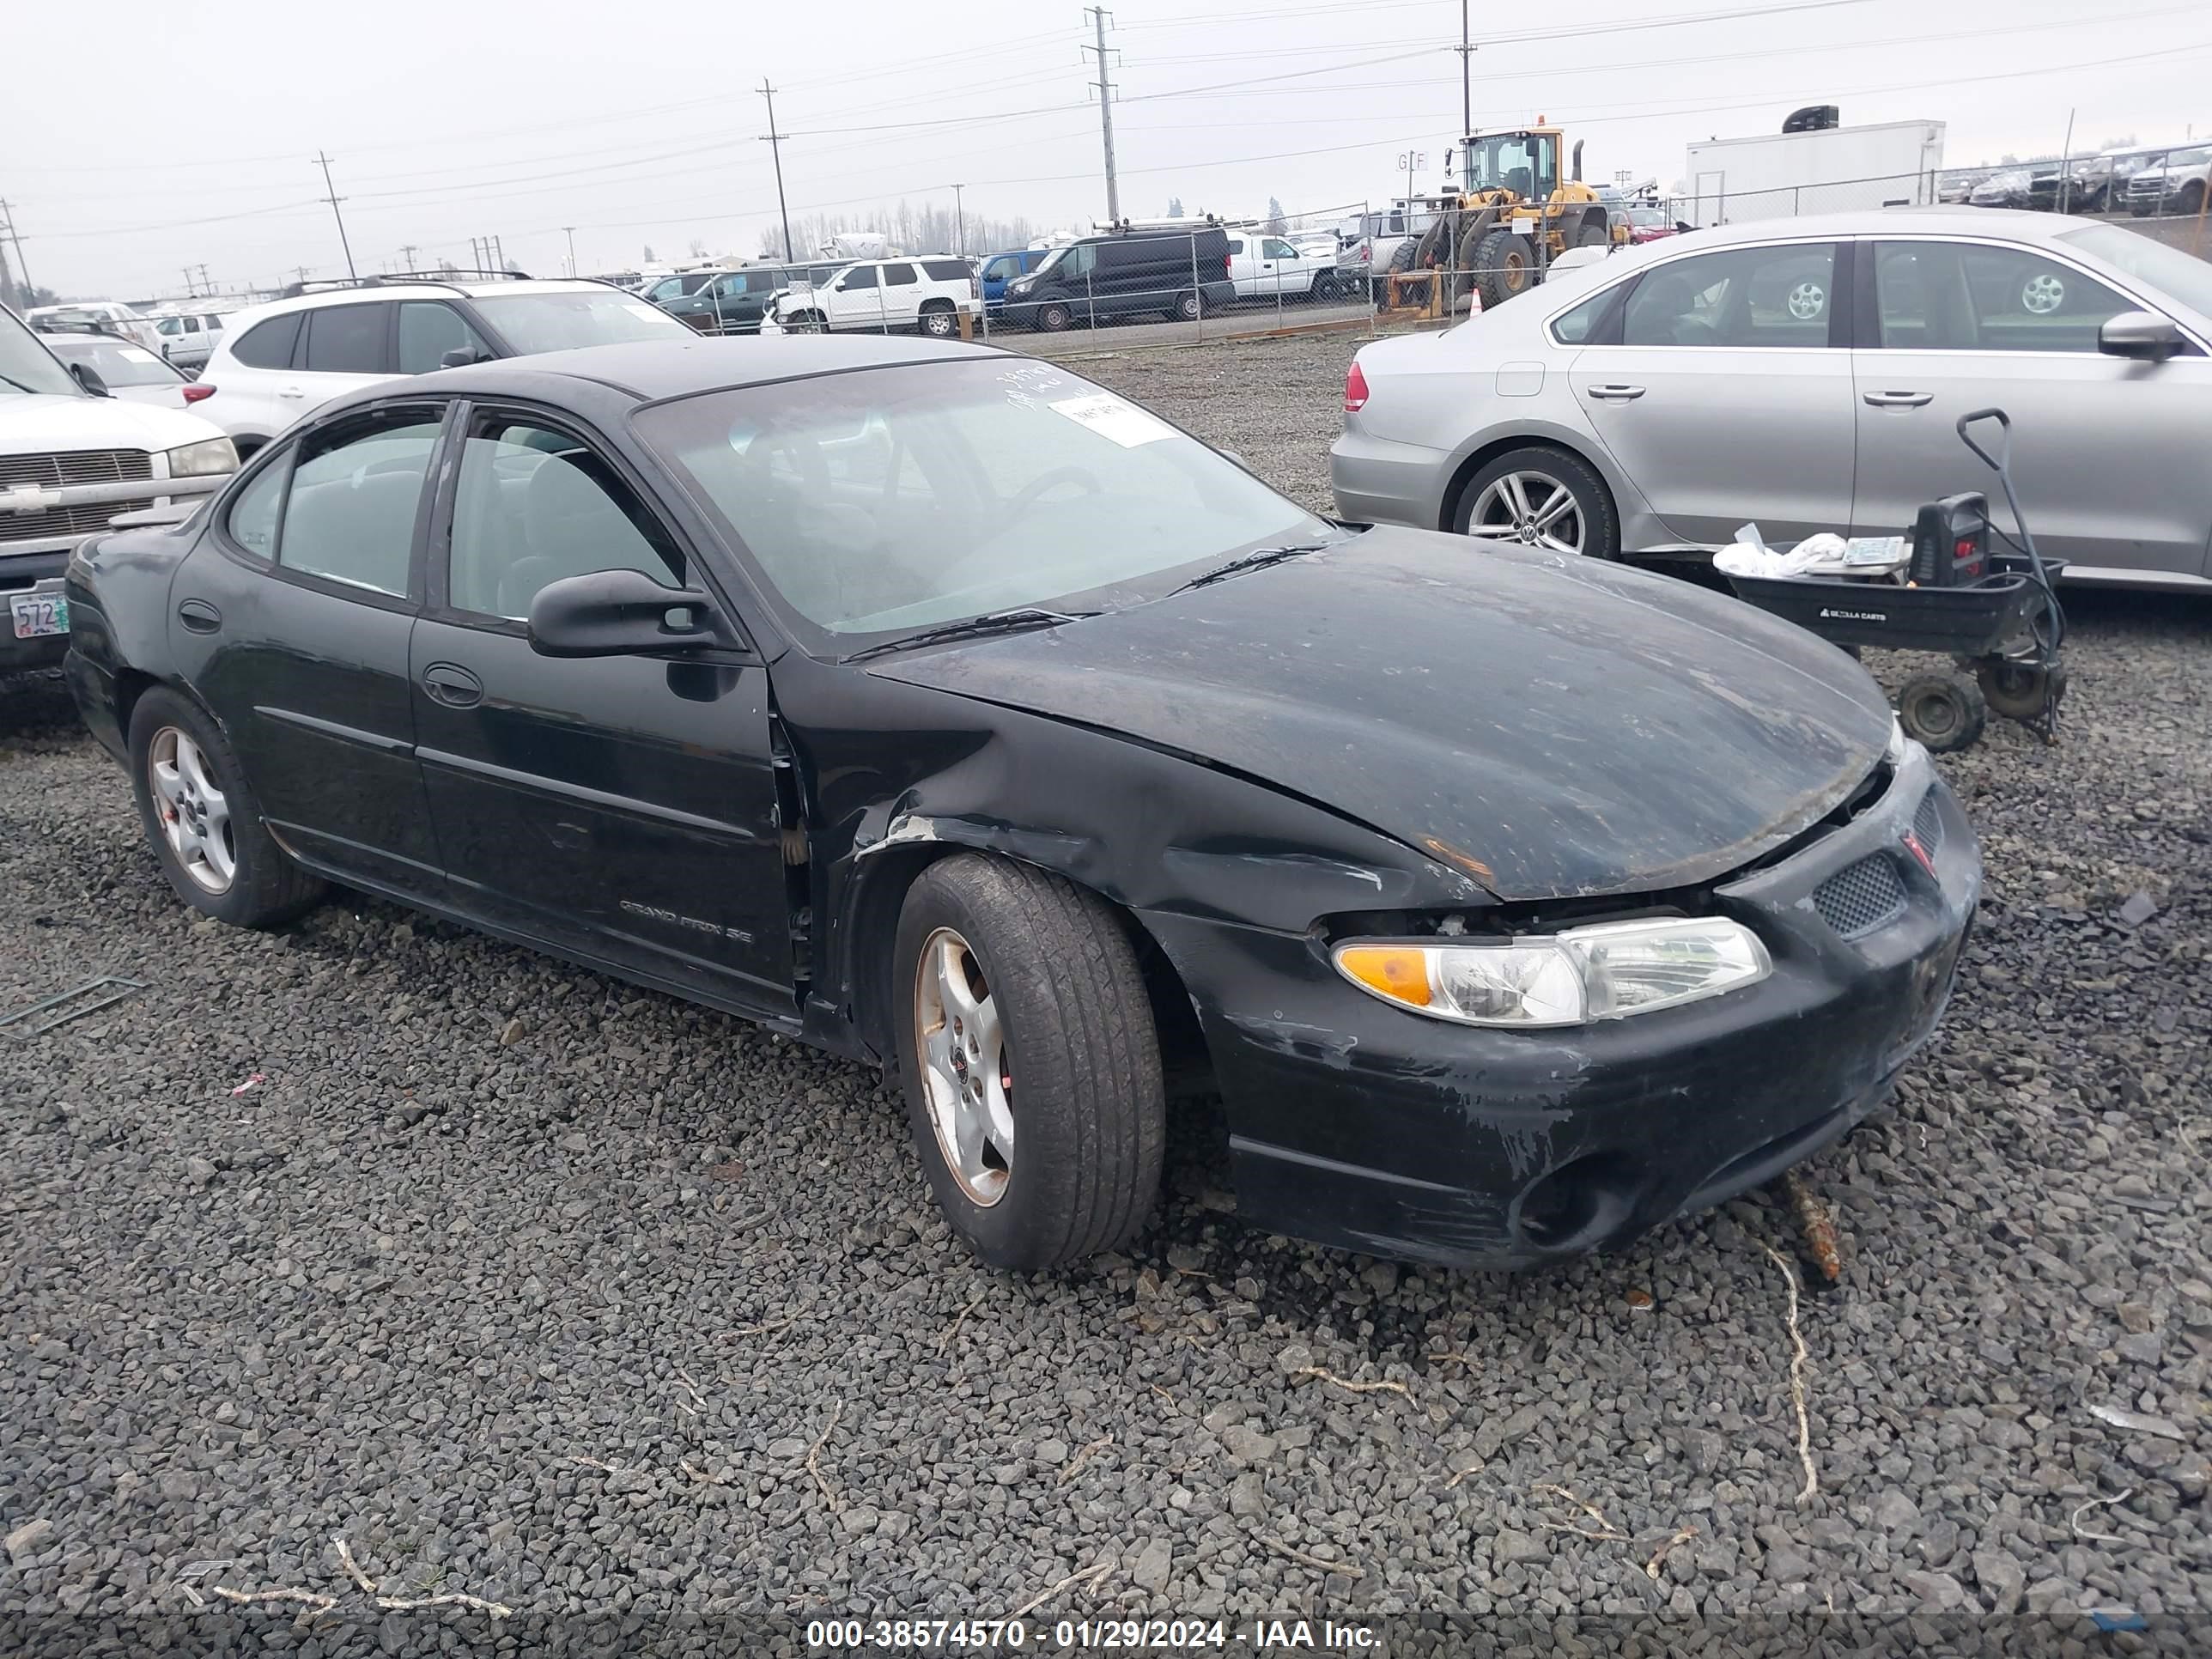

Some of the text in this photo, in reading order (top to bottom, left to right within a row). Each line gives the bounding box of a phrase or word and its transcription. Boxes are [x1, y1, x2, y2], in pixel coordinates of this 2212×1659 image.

[1399, 154, 1407, 170] G
[1417, 153, 1425, 169] F
[17, 603, 55, 629] 572
[619, 900, 753, 944] GRAND PRIX SE
